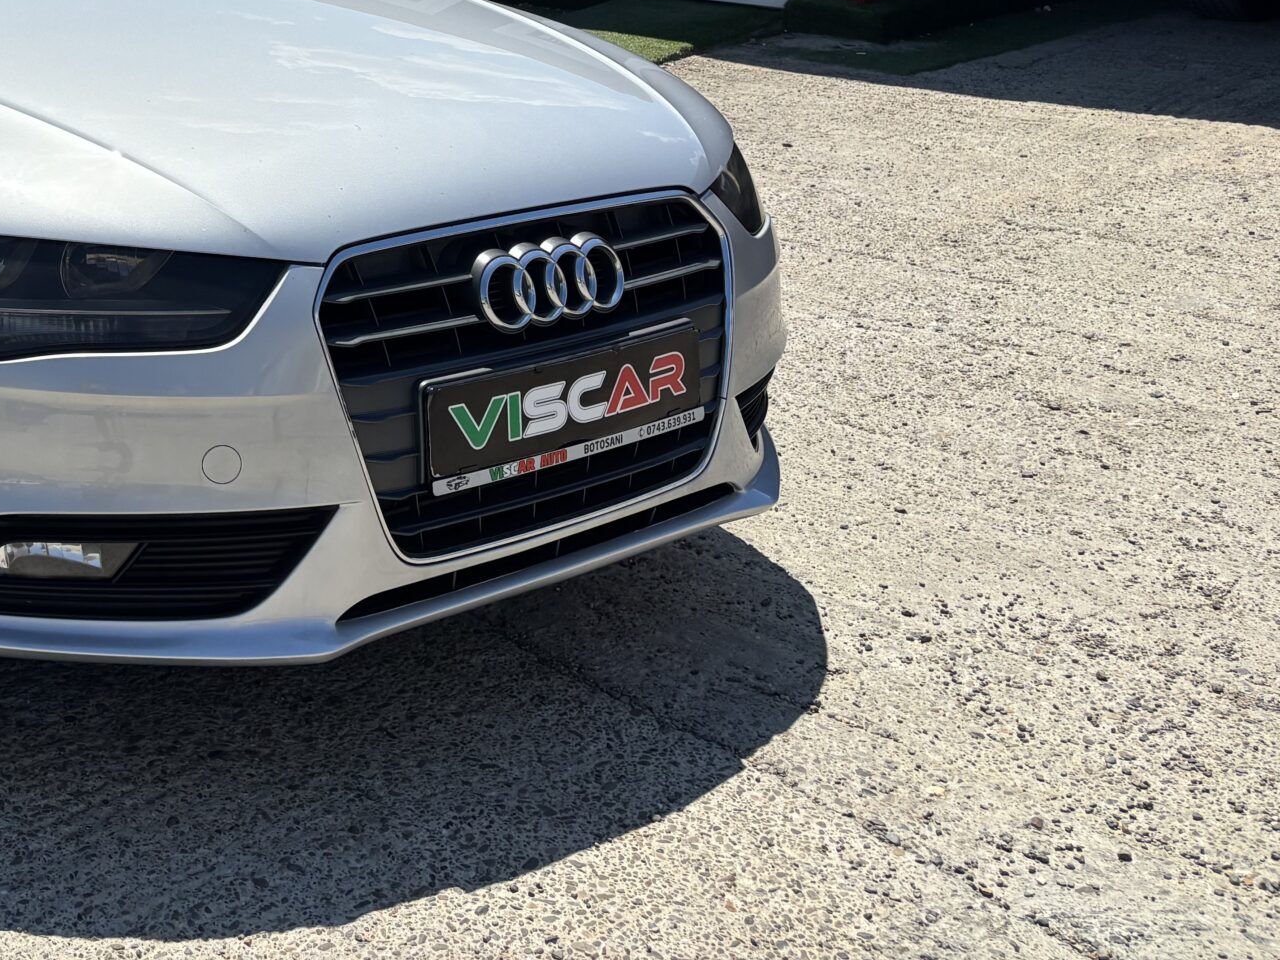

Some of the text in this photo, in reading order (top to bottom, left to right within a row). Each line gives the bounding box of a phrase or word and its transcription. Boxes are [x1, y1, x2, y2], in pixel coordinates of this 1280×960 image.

[448, 351, 687, 450] VISCAR
[646, 411, 696, 436] 0743.639.931
[489, 434, 624, 481] VISCAR AUTO BOTOSANI
